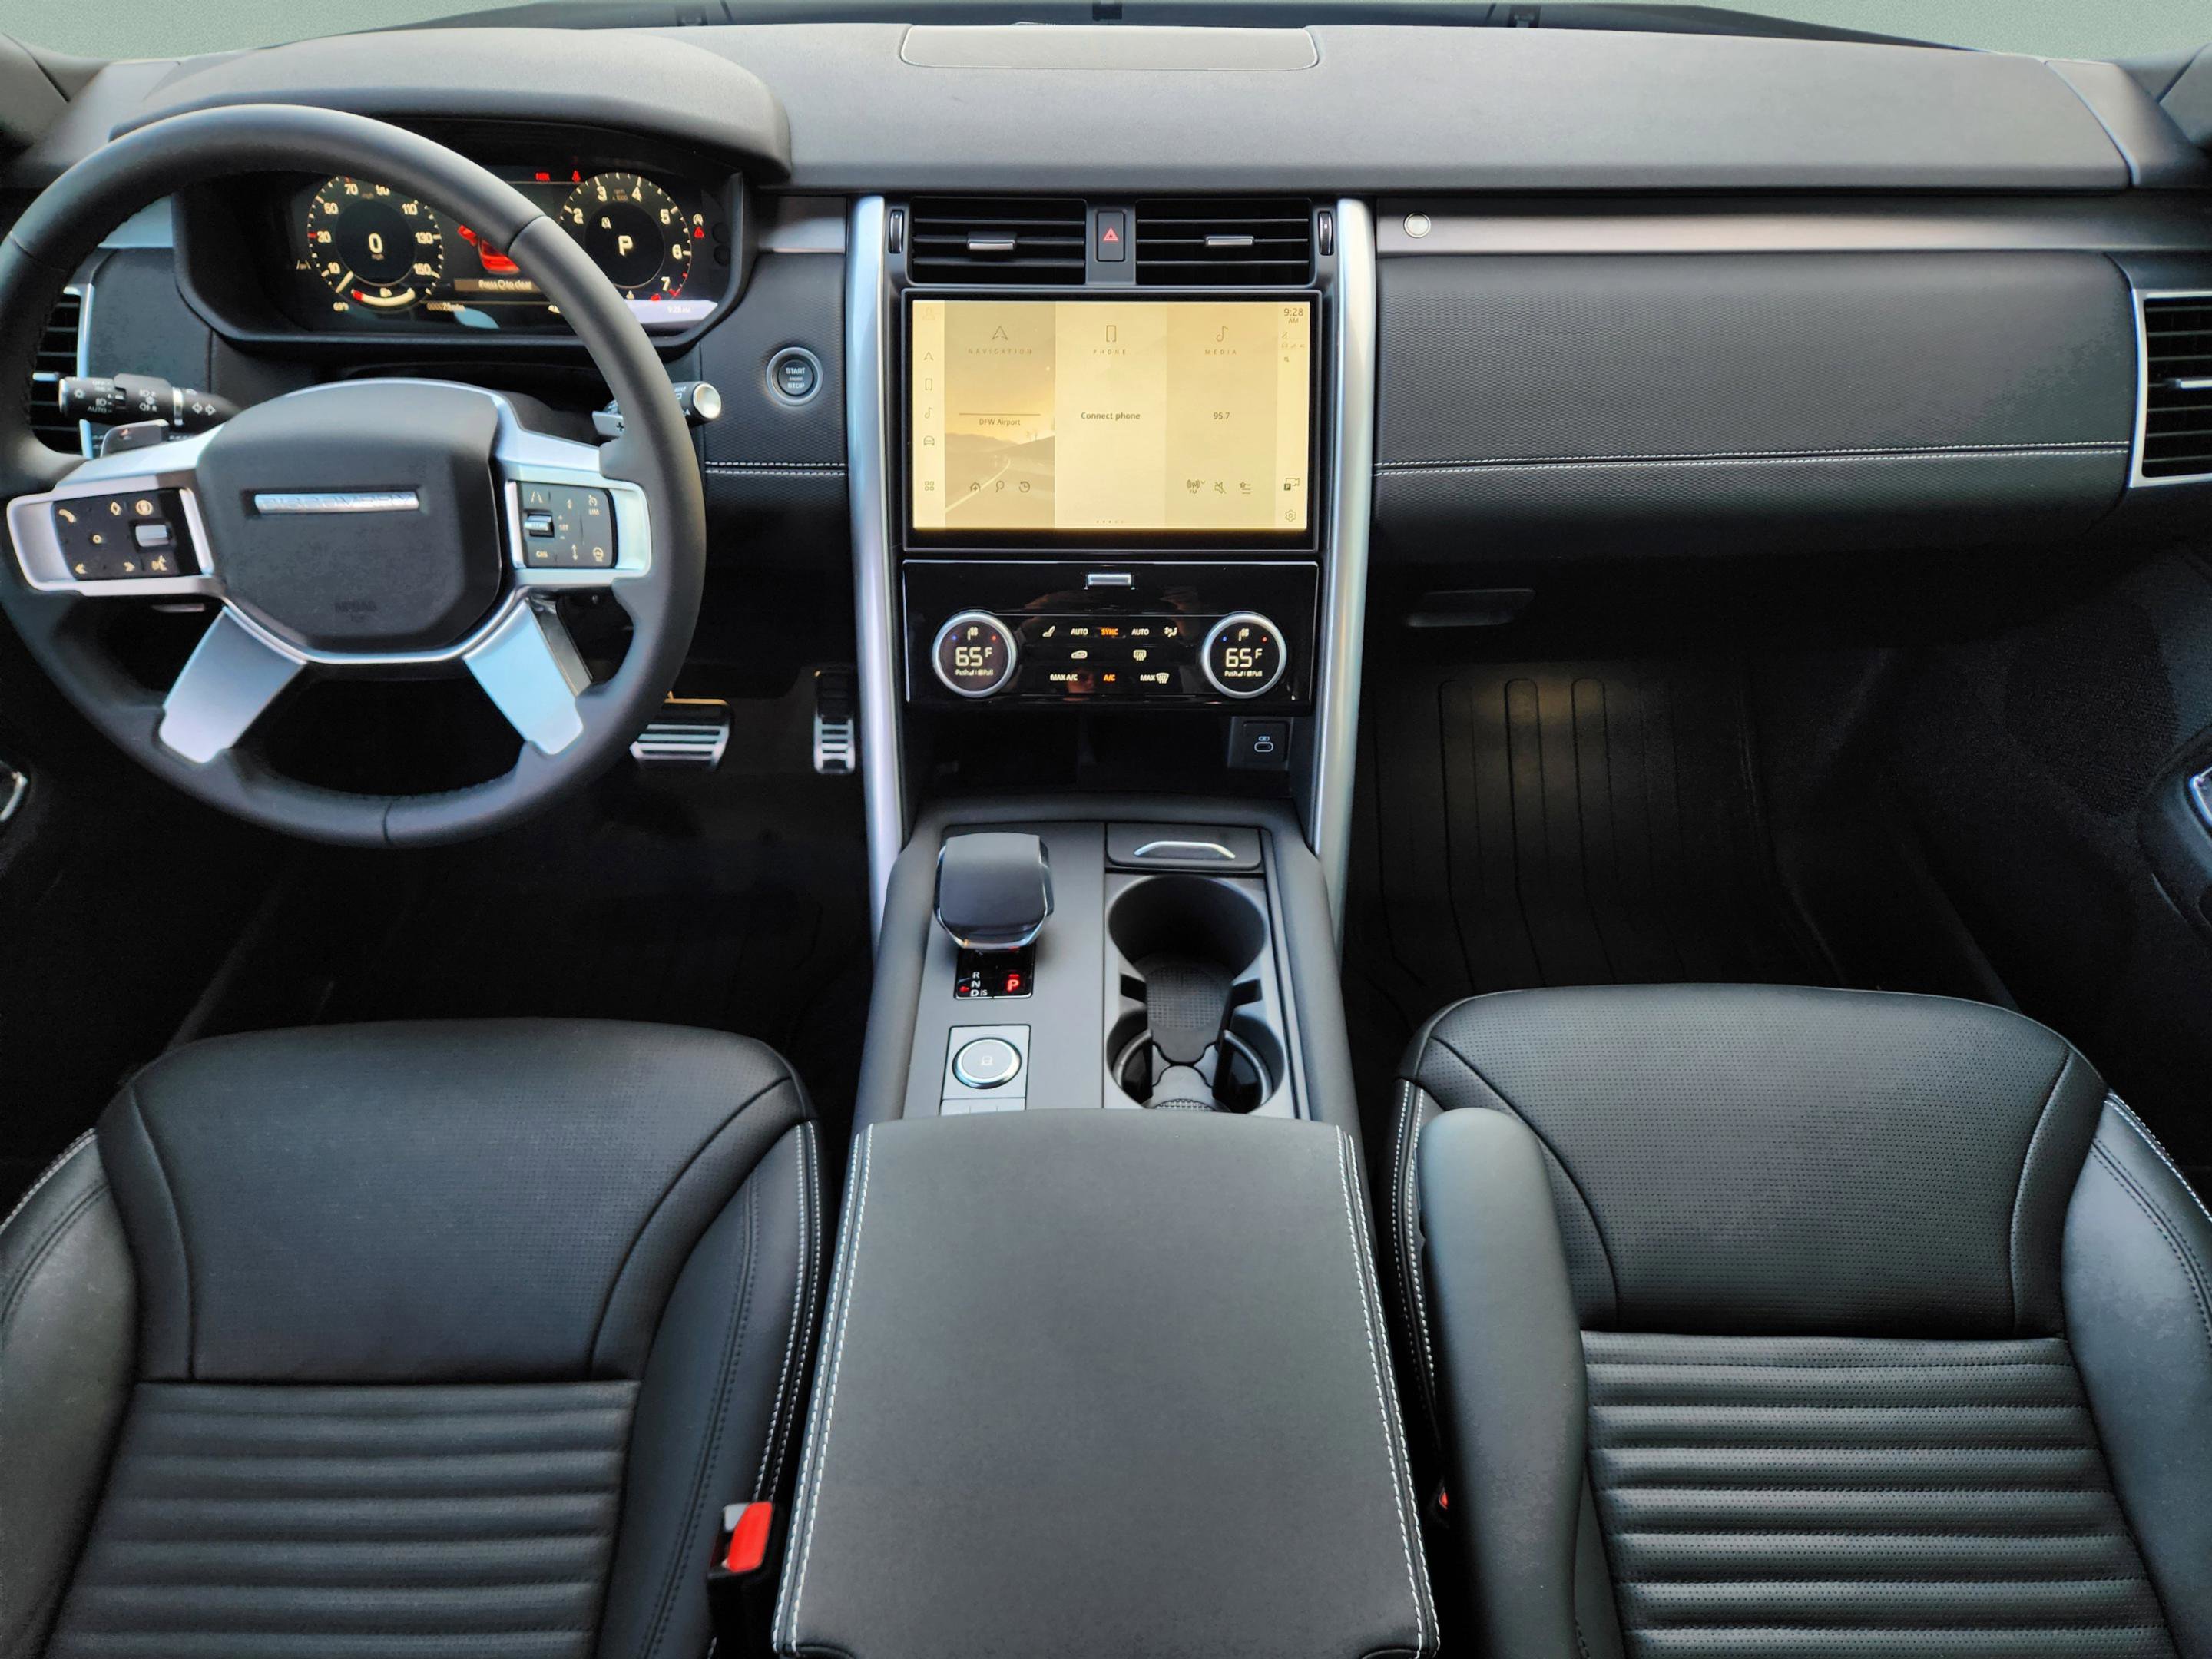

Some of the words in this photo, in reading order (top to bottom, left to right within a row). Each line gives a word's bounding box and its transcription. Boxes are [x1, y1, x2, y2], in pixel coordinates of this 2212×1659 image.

[345, 183, 359, 195] 70
[597, 186, 608, 202] 3
[631, 187, 642, 202] 4
[402, 203, 418, 215] 110
[573, 208, 584, 224] 2
[660, 208, 671, 225] 5
[317, 231, 332, 243] 30
[368, 233, 383, 253] 0
[415, 232, 434, 244] 130
[618, 235, 633, 256] P
[672, 243, 683, 260] 6
[328, 262, 340, 274] 10
[661, 276, 671, 291] 7
[1283, 308, 1303, 316] 9:28
[87, 405, 108, 413] AUTO
[979, 418, 995, 426] DFW
[997, 417, 1022, 427] Airport
[1081, 411, 1114, 420] Connect
[1115, 412, 1141, 422] phone
[1213, 412, 1230, 420] 95.7
[955, 647, 983, 667] 65
[985, 647, 992, 658] F
[1225, 647, 1253, 668] 65
[1255, 647, 1263, 659] F
[1066, 673, 1078, 681] A/C
[1103, 674, 1116, 682] A/C
[1007, 978, 1020, 992] P
